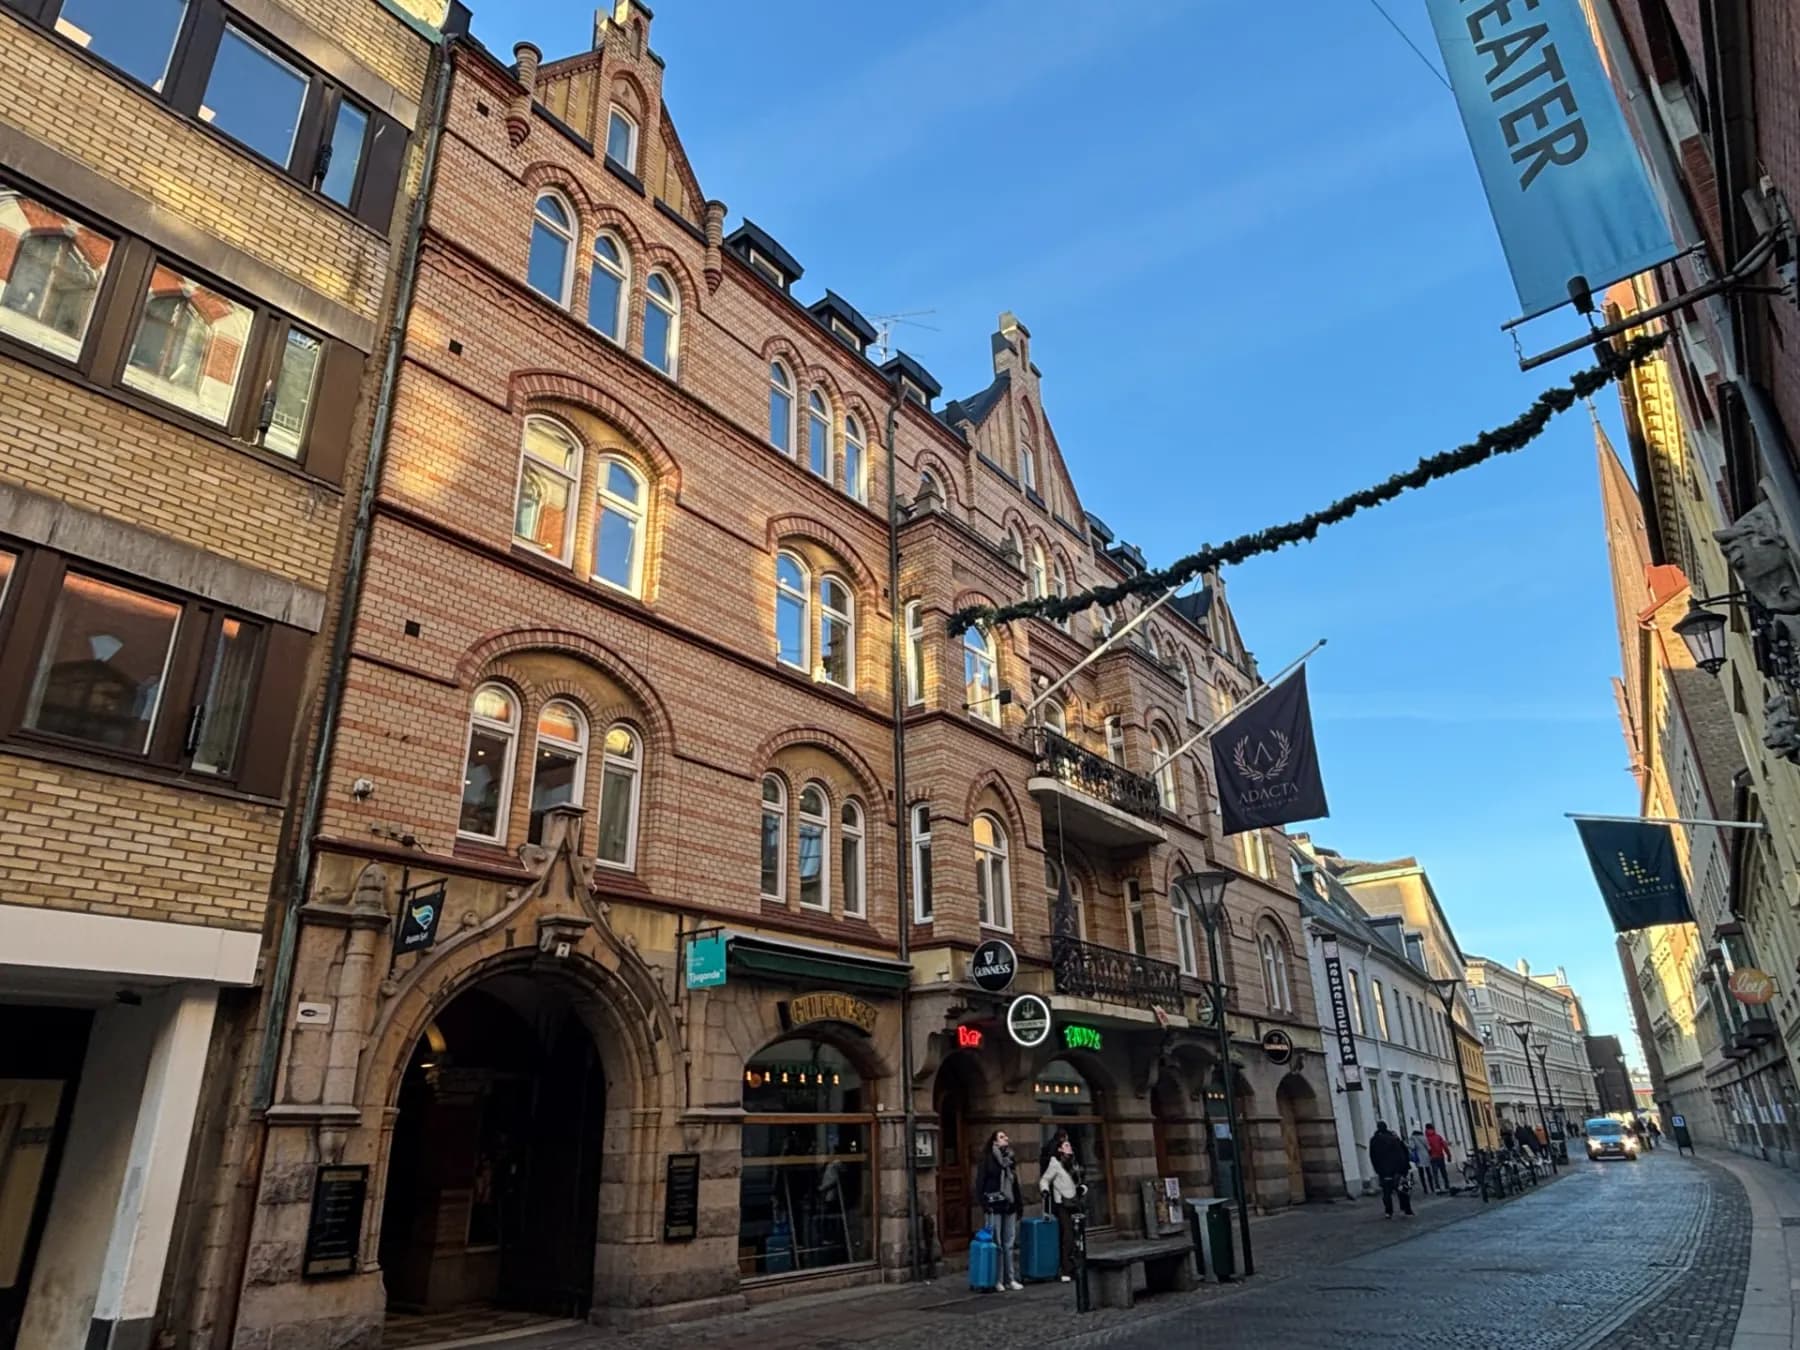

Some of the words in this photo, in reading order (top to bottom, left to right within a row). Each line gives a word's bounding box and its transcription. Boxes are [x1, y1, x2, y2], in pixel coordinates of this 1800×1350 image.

[1460, 0, 1589, 192] EATER
[974, 963, 1011, 978] GUINNESS
[1328, 962, 1355, 1061] teatermuseet
